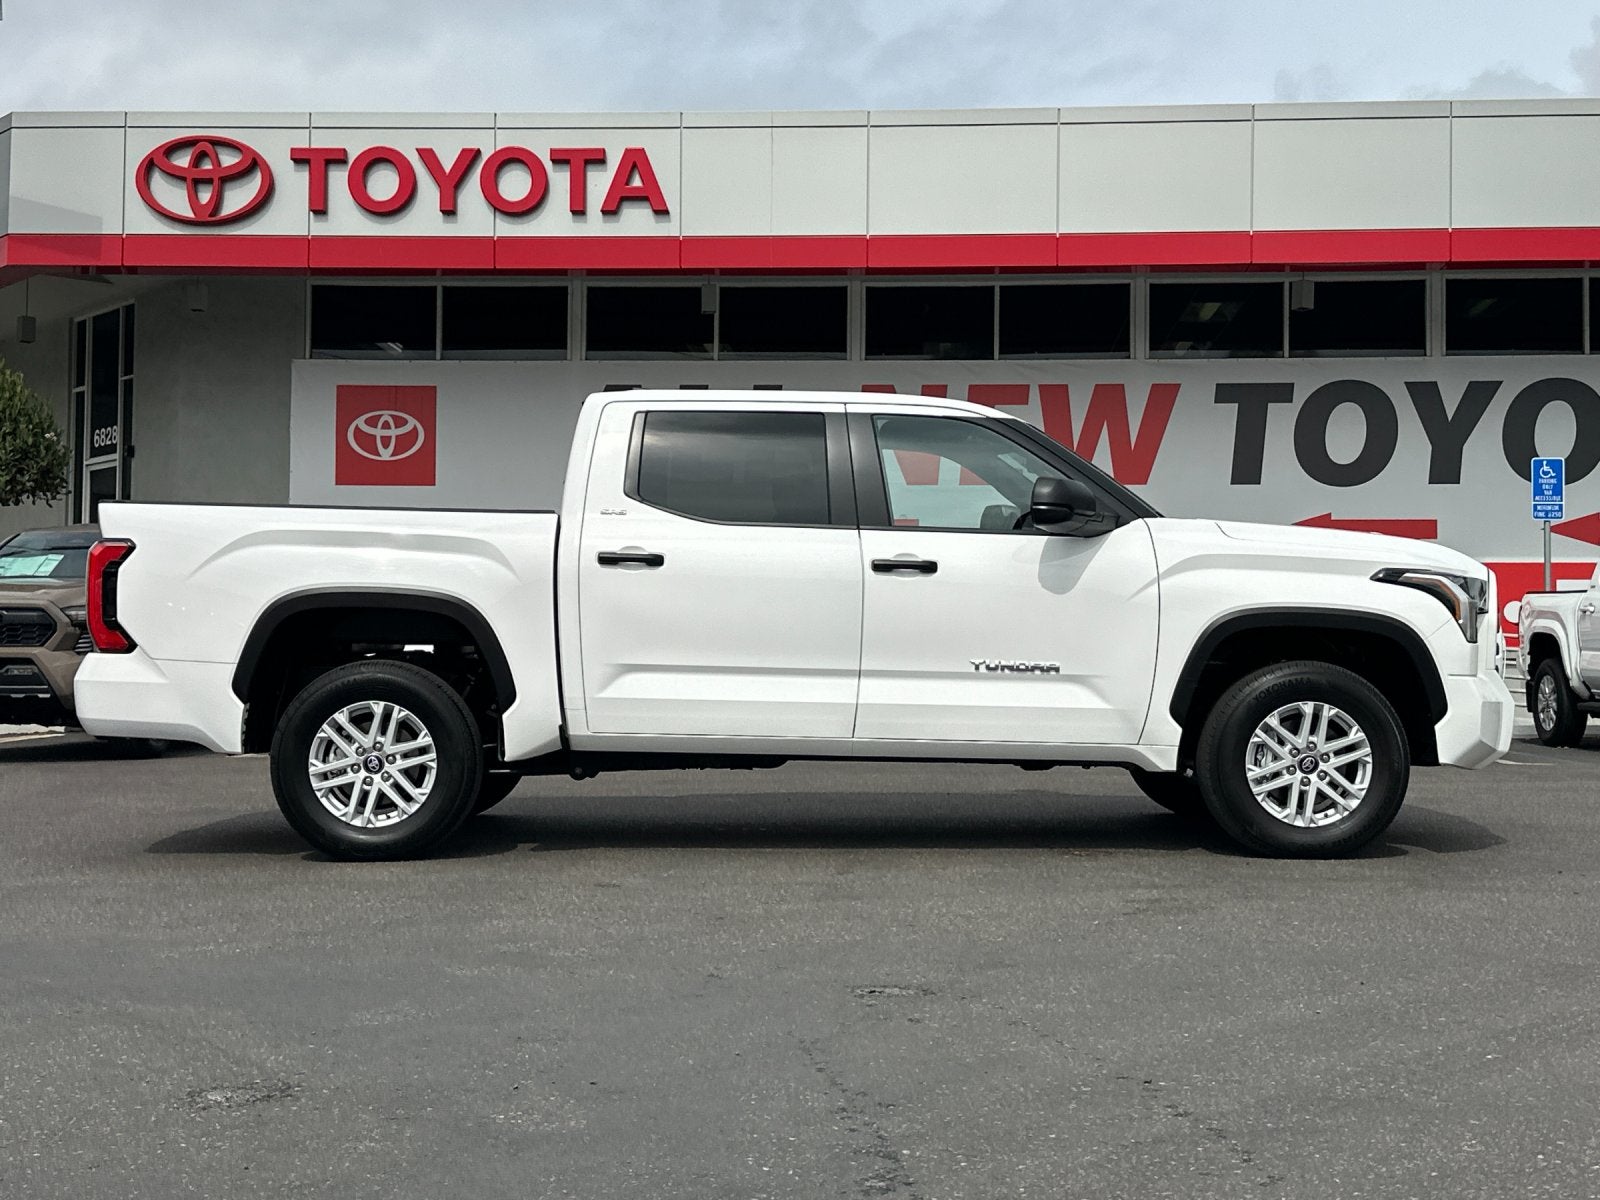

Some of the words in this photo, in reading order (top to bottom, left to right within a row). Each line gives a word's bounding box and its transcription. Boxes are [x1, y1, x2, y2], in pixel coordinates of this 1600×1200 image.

[290, 145, 670, 216] TOYOTA
[94, 425, 118, 448] 6828
[1214, 377, 1600, 488] TOYO
[969, 659, 1061, 673] TUNDRA
